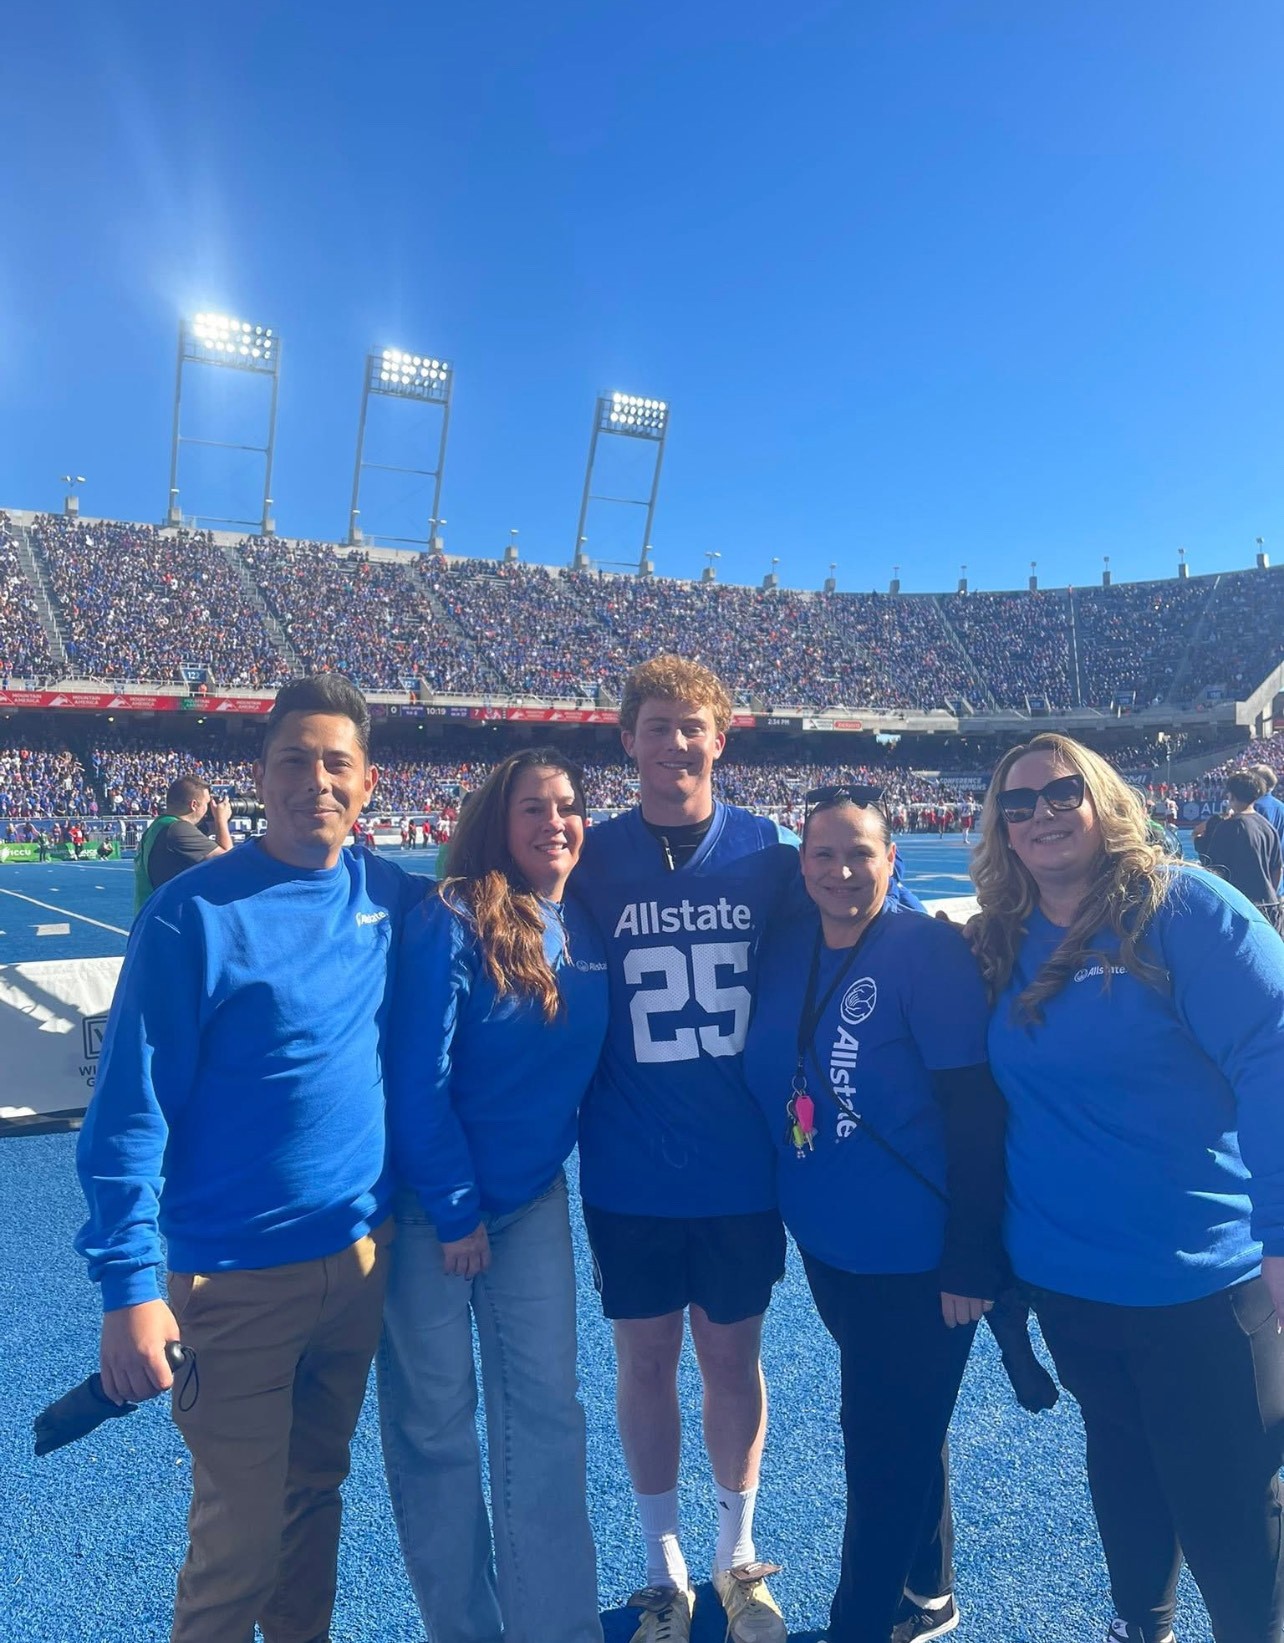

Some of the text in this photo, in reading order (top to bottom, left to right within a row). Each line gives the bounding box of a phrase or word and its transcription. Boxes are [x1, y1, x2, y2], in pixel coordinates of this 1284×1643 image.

[426, 707, 446, 715] 10:19
[613, 897, 751, 938] Allstate
[623, 941, 751, 1063] 25
